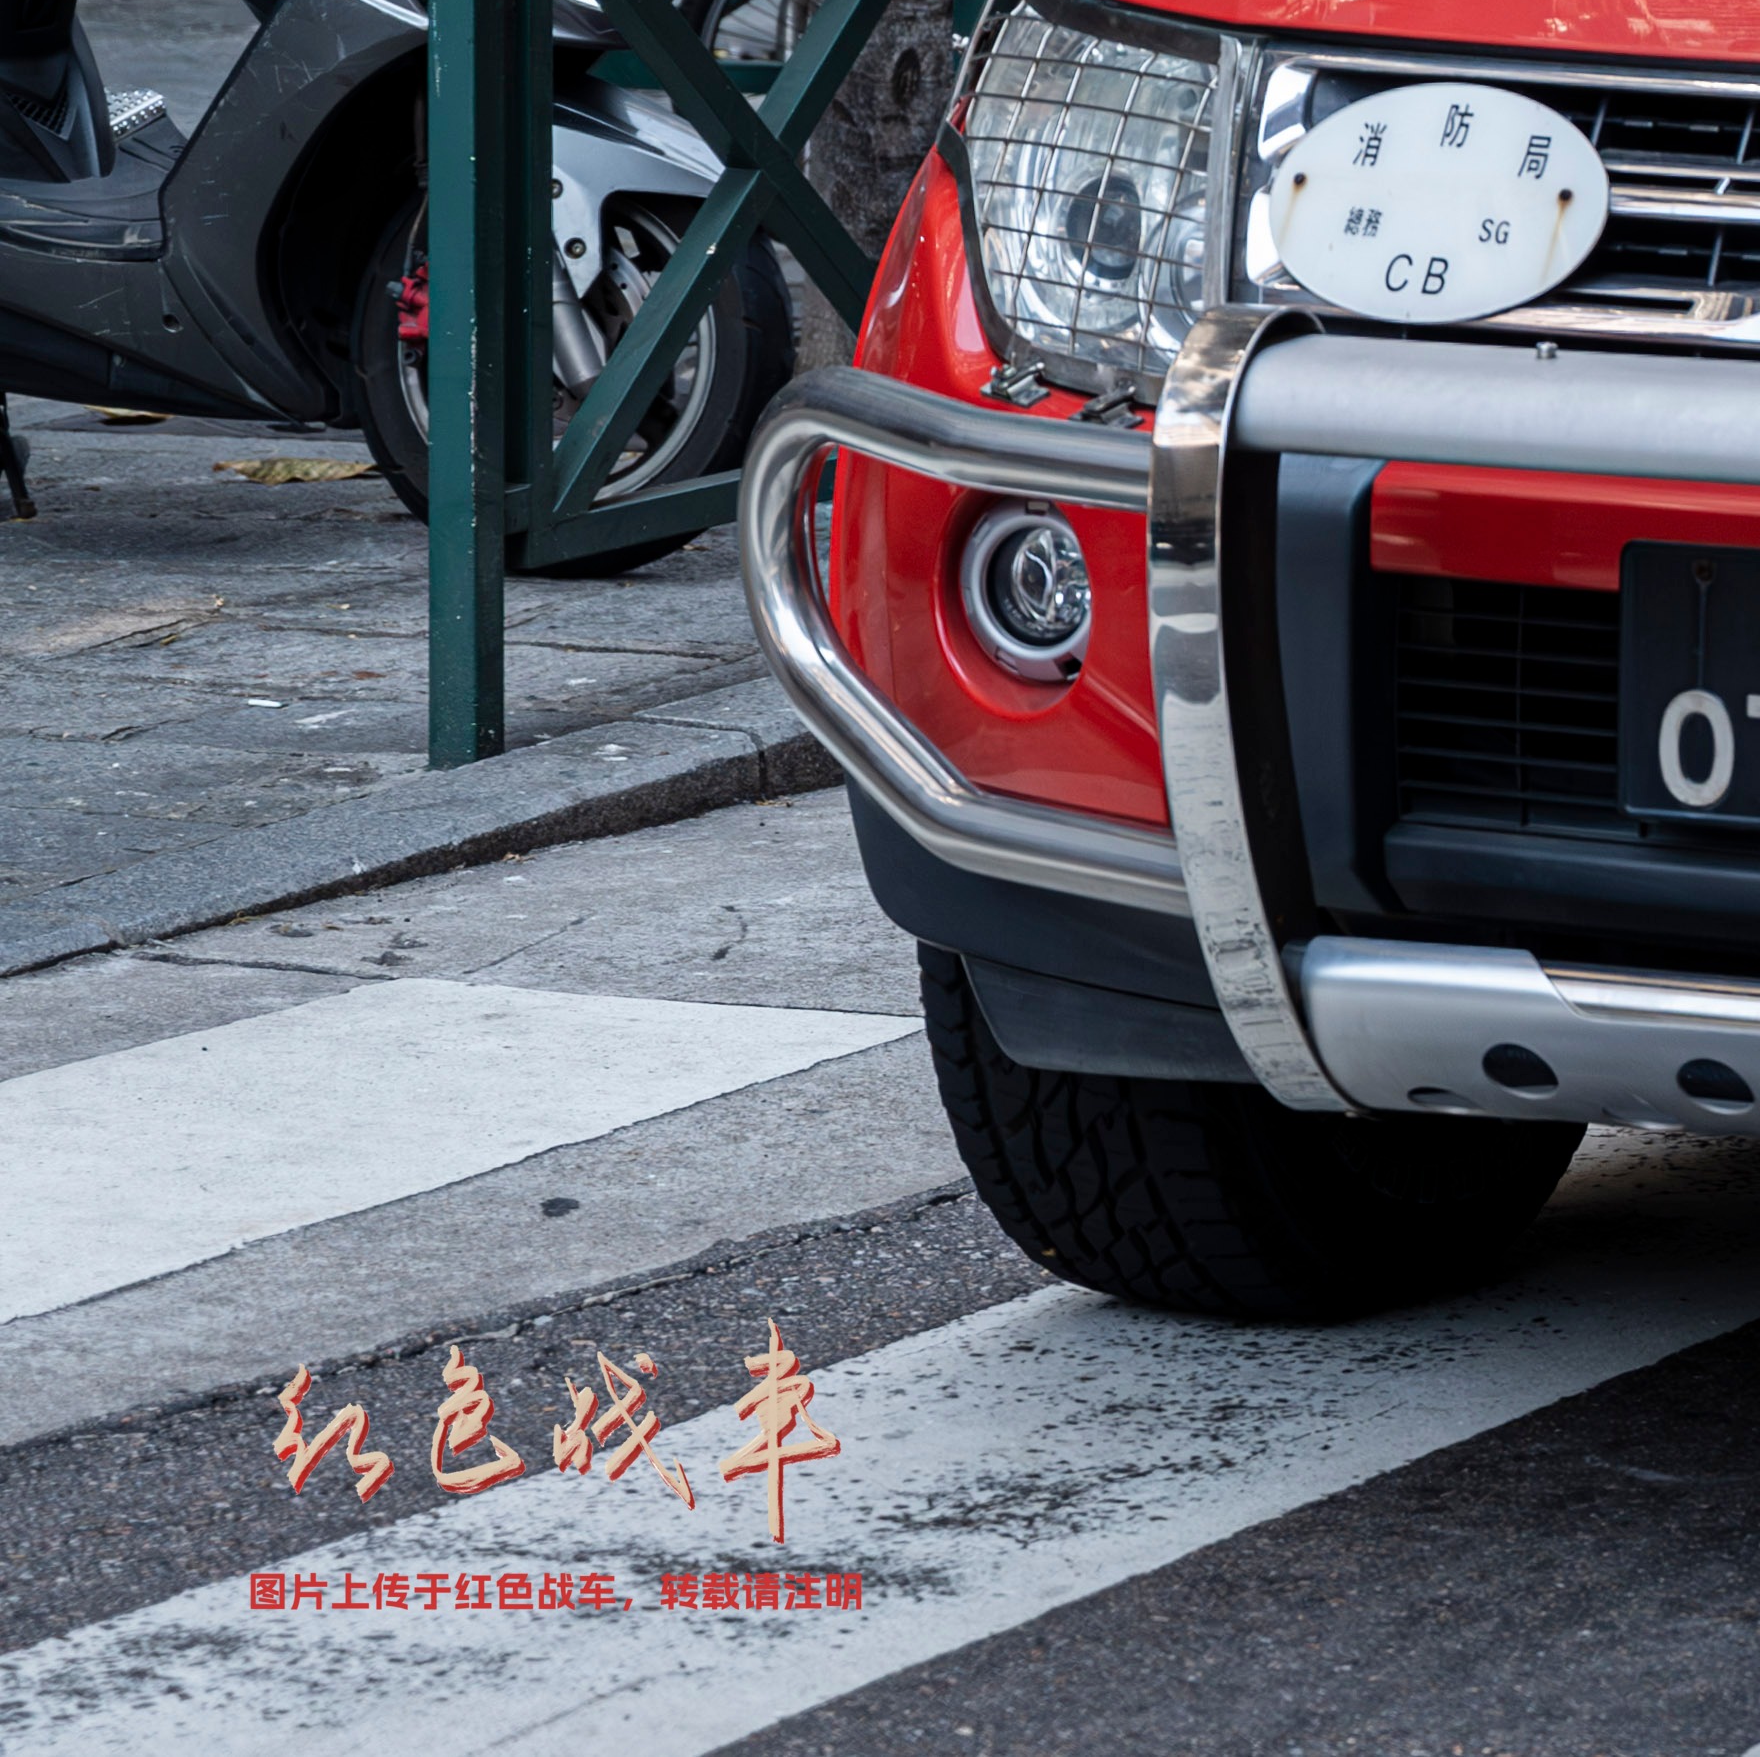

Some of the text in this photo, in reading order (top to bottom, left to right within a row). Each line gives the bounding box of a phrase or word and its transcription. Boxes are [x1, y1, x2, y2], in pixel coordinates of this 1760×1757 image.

[1352, 103, 1553, 181] 消防局
[1478, 218, 1511, 245] SG
